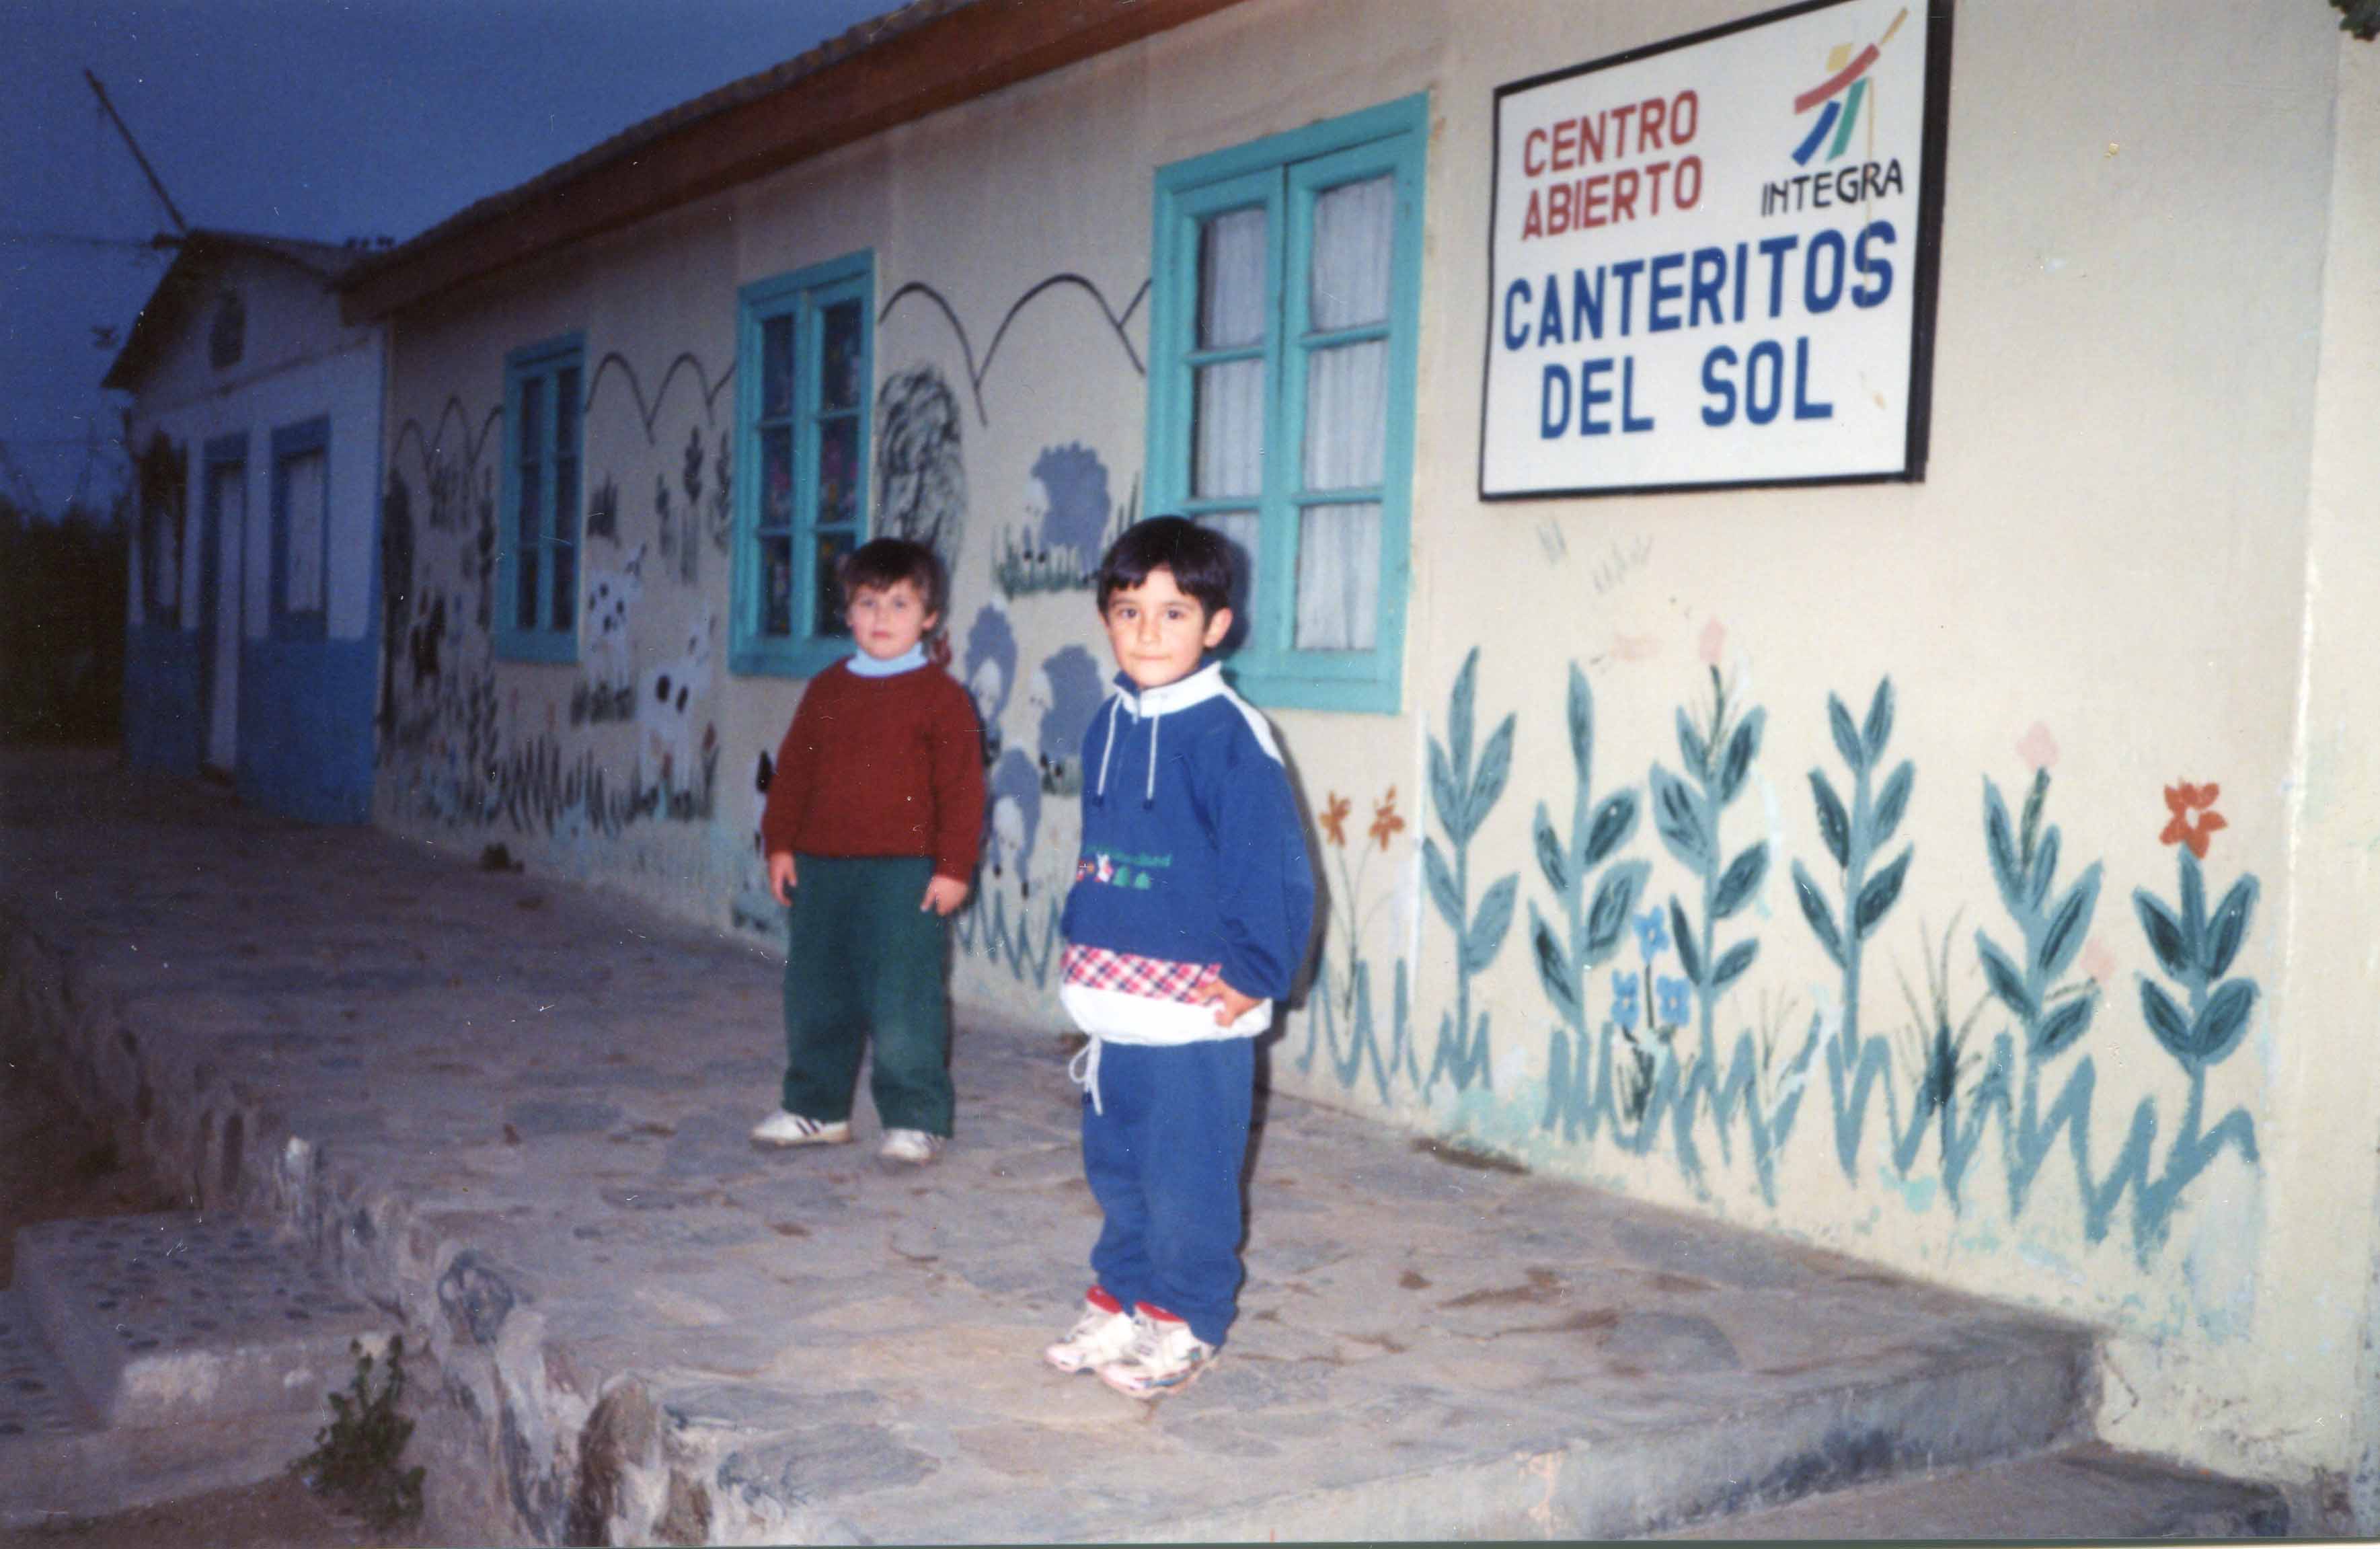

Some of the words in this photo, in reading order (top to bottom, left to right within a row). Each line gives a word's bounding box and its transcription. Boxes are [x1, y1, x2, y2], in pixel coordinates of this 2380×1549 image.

[1523, 89, 1699, 178] CENTRO
[1521, 155, 1703, 242] ABIERTO
[1761, 157, 1905, 217] INTEGRA
[1502, 220, 1897, 352] CANTERITOS
[1540, 355, 1654, 440] DEL
[1700, 336, 1833, 428] SOL
